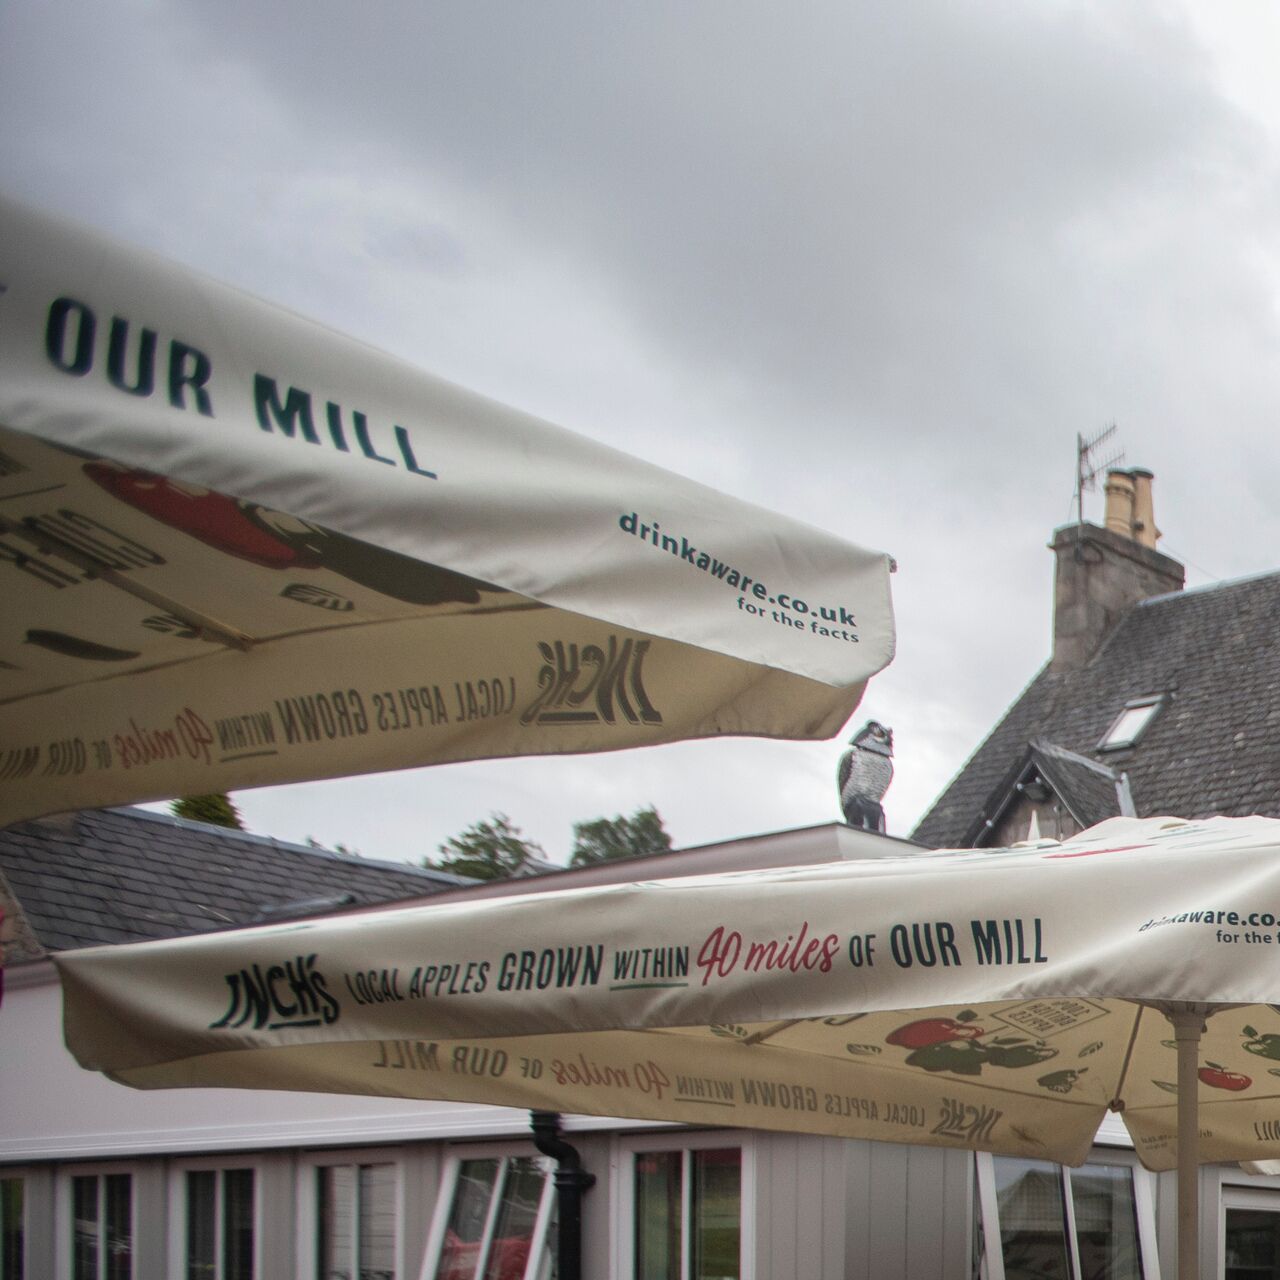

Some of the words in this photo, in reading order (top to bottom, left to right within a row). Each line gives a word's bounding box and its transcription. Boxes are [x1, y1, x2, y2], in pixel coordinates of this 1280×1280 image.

[46, 297, 215, 418] OUR
[254, 373, 438, 480] MILL
[619, 512, 857, 627] drinkaware.co.uk
[737, 597, 766, 617] for
[772, 611, 804, 630] the
[810, 621, 860, 643] facts
[209, 953, 340, 1030] INCH'S
[344, 968, 405, 1005] LOCAL
[410, 961, 491, 1000] APPLES
[497, 944, 604, 992] GROWN
[612, 946, 689, 980] WITHIN
[697, 926, 743, 987] 40
[744, 921, 841, 976] miles
[849, 934, 876, 967] OF
[890, 922, 961, 968] OUR
[971, 918, 1048, 965] MILL
[1216, 930, 1239, 943] for
[1245, 931, 1272, 944] the
